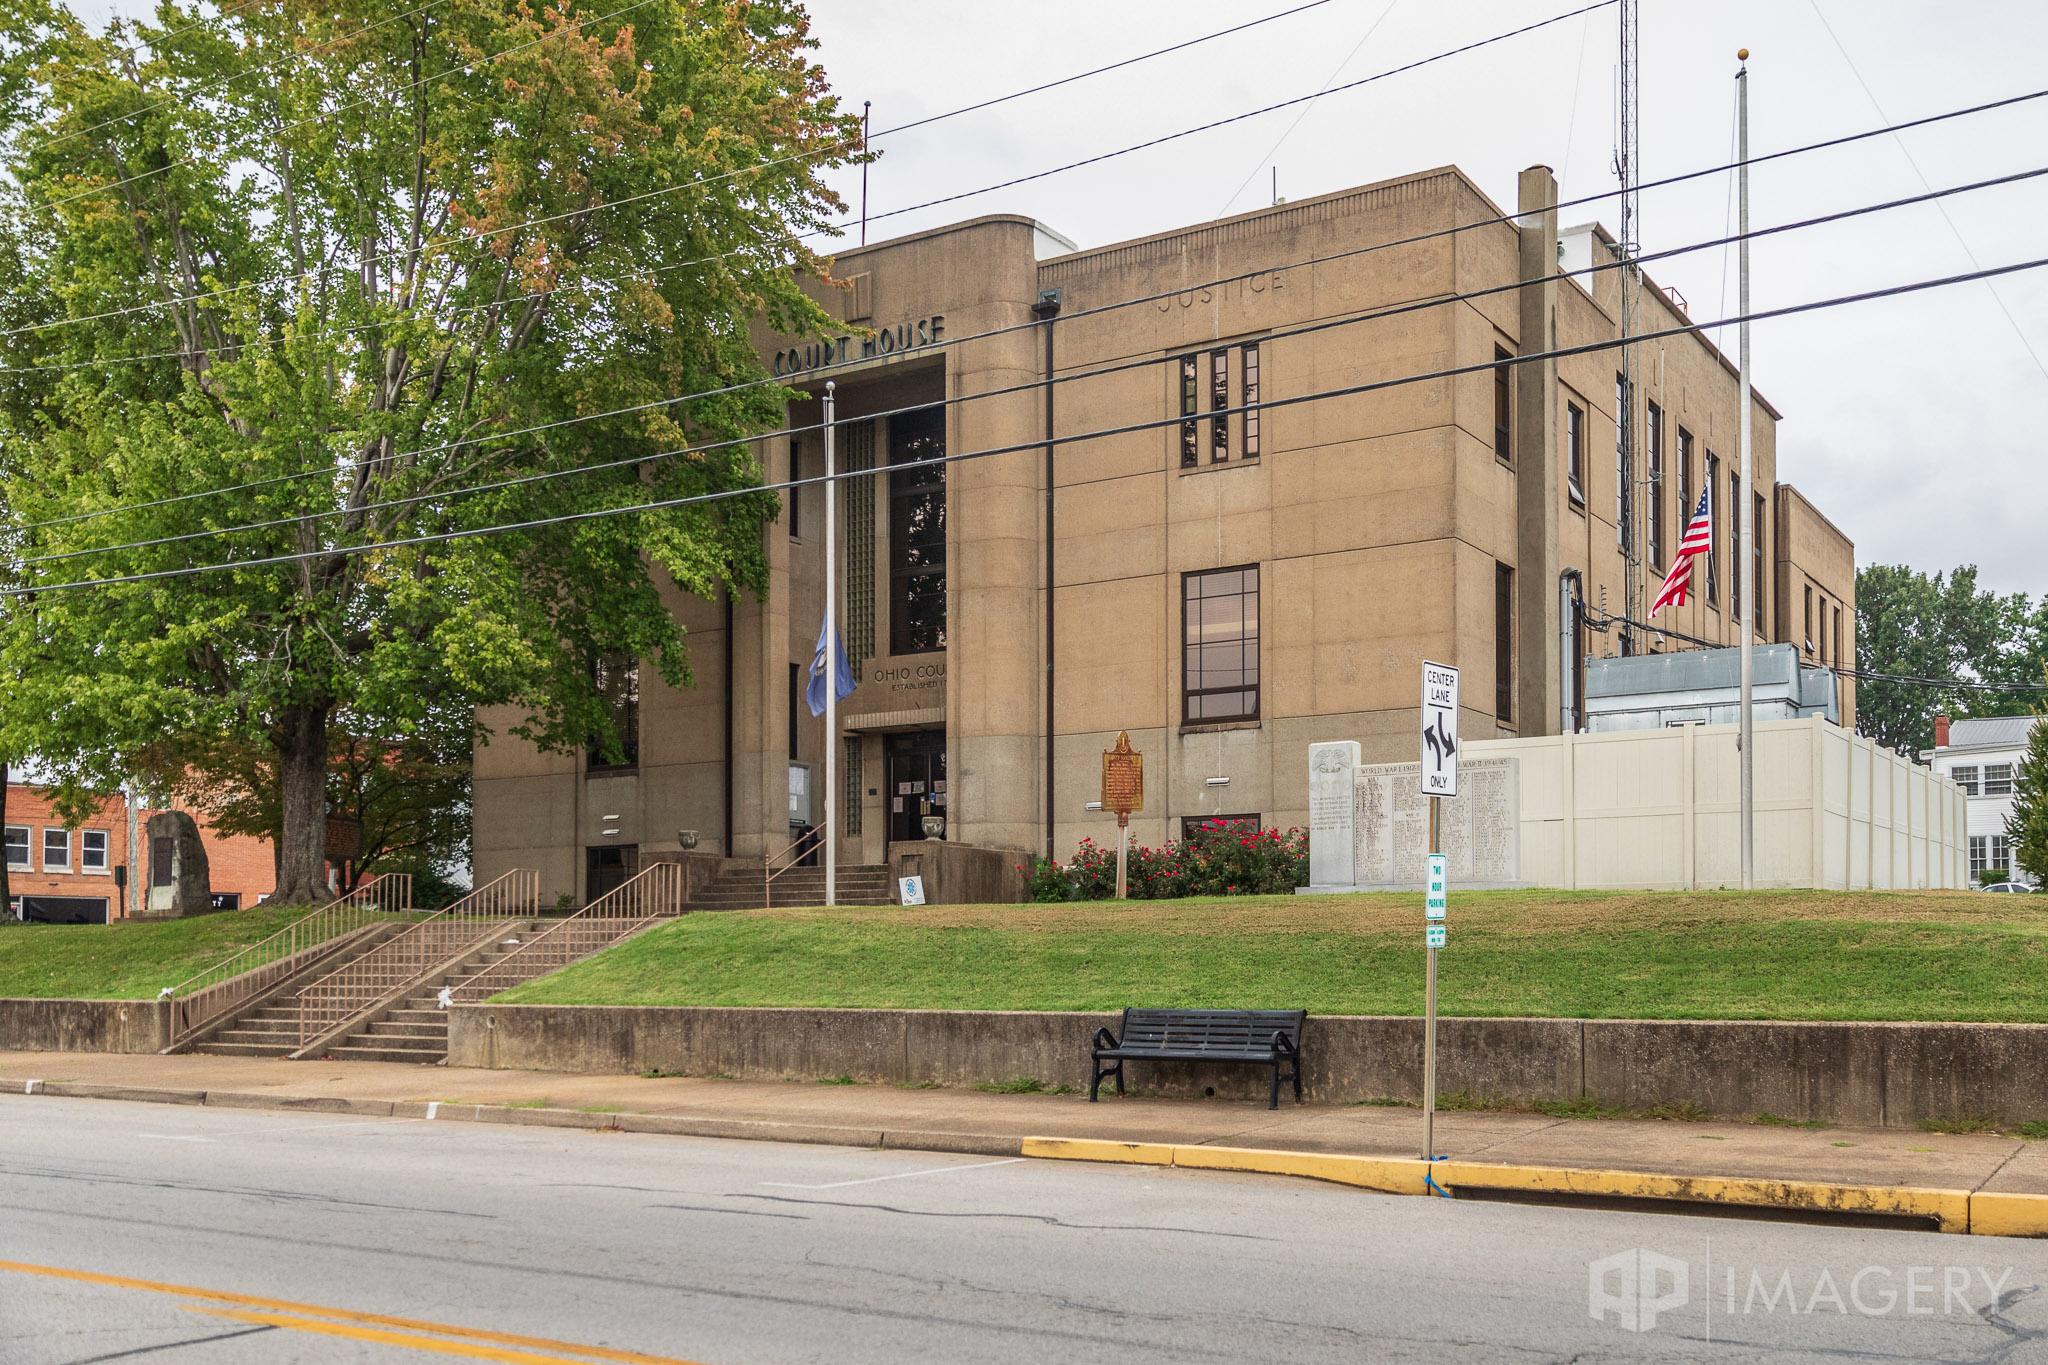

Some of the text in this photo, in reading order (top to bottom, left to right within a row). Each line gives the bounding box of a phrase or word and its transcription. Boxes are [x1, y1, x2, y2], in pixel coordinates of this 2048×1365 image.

[774, 315, 945, 376] COURT HOUSE
[874, 664, 947, 682] OHIO COU
[1427, 670, 1455, 687] CENTER
[892, 681, 937, 691] ESTABLISHED
[1431, 687, 1450, 703] LANE
[1385, 766, 1398, 774] WAR
[1430, 775, 1448, 789] ONLY
[1433, 865, 1441, 876] TWO
[1431, 882, 1442, 892] HOUR
[1428, 898, 1445, 908] PARKING
